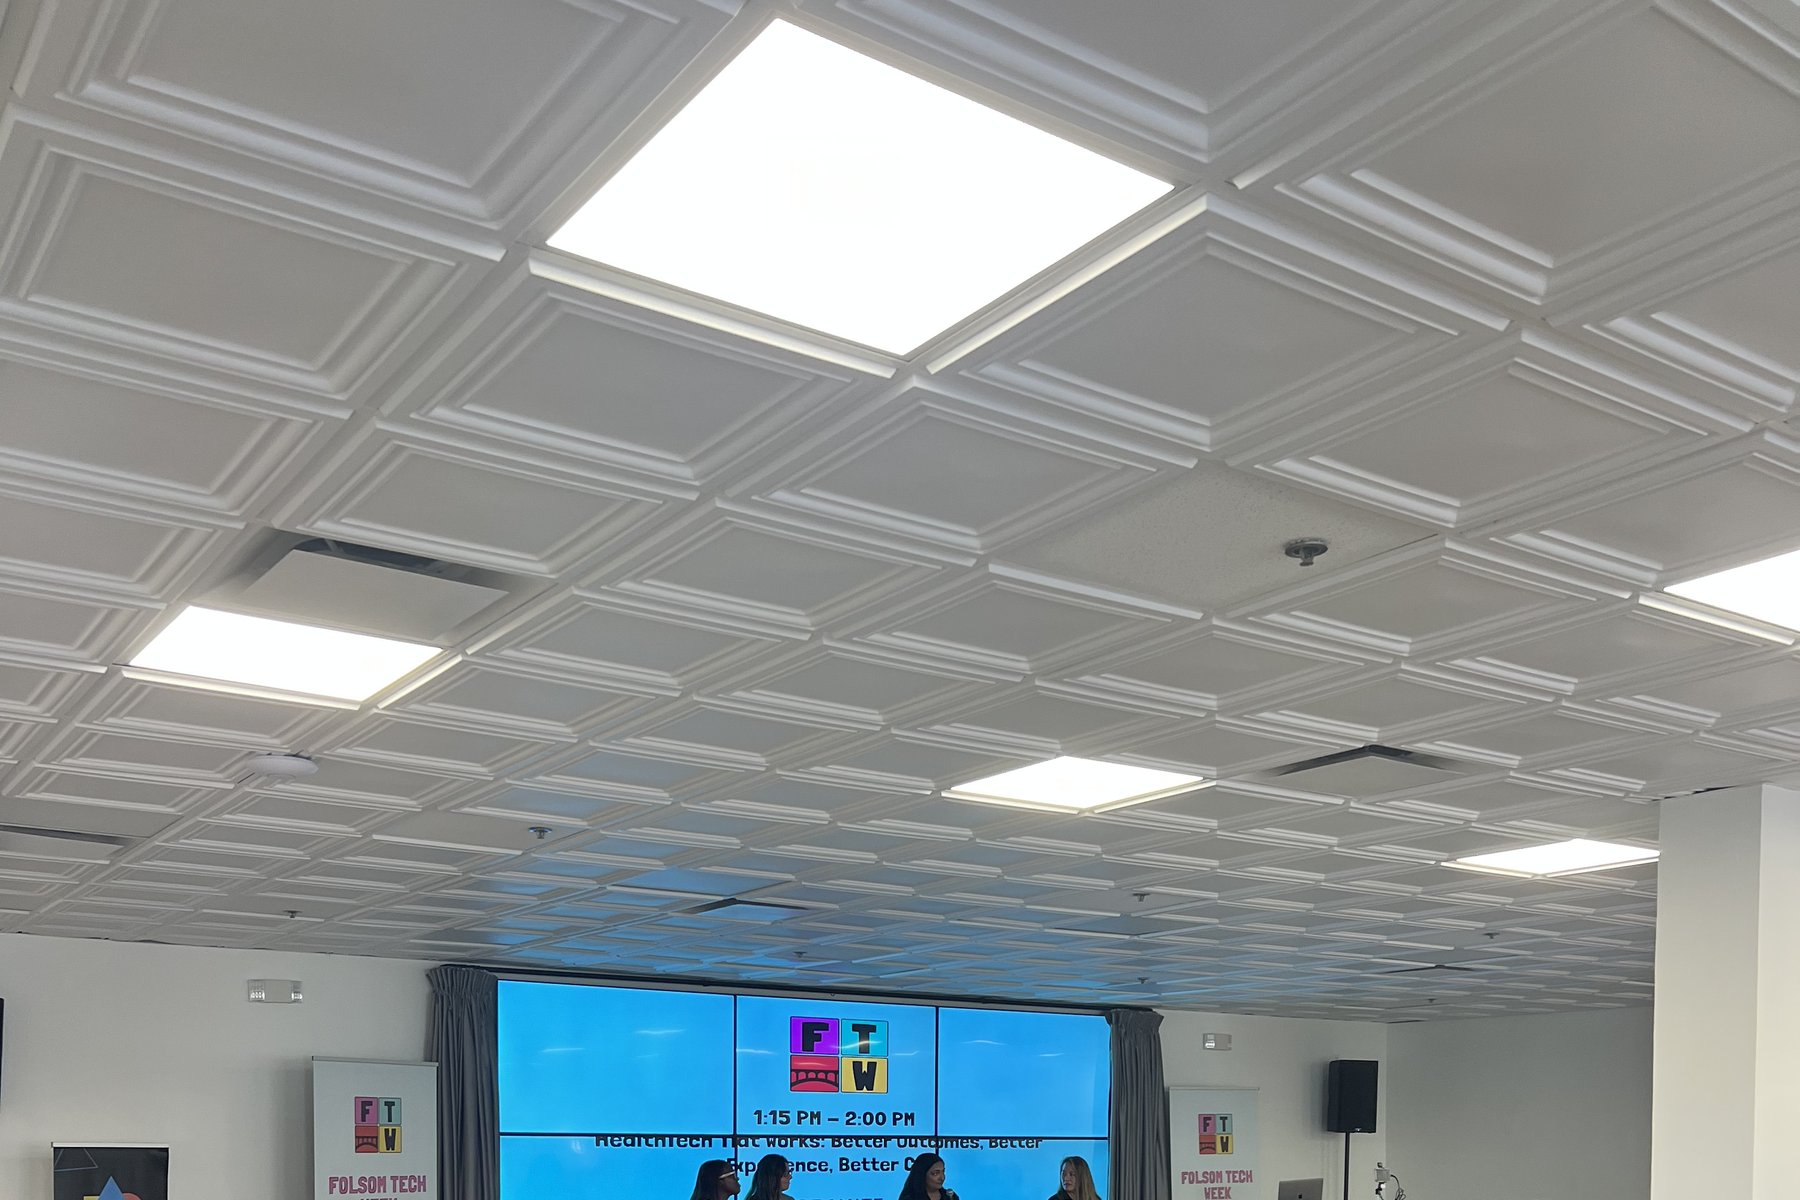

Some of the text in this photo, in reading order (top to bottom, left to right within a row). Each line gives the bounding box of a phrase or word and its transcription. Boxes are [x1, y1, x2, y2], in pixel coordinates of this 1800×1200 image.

[802, 1022, 876, 1054] F T
[852, 1061, 877, 1091] W
[361, 1101, 395, 1122] F T
[754, 1110, 791, 1125] 1:15
[797, 1111, 821, 1125] PM
[846, 1112, 887, 1126] 2:00
[892, 1112, 915, 1126] PM
[1203, 1117, 1228, 1132] F T
[384, 1128, 396, 1150] W
[1221, 1136, 1229, 1152] W
[839, 1157, 899, 1172] Better
[328, 1175, 427, 1195] FOLSOM TECH
[1181, 1170, 1254, 1185] FOLSOM TECH
[1204, 1187, 1232, 1200] WEEK
